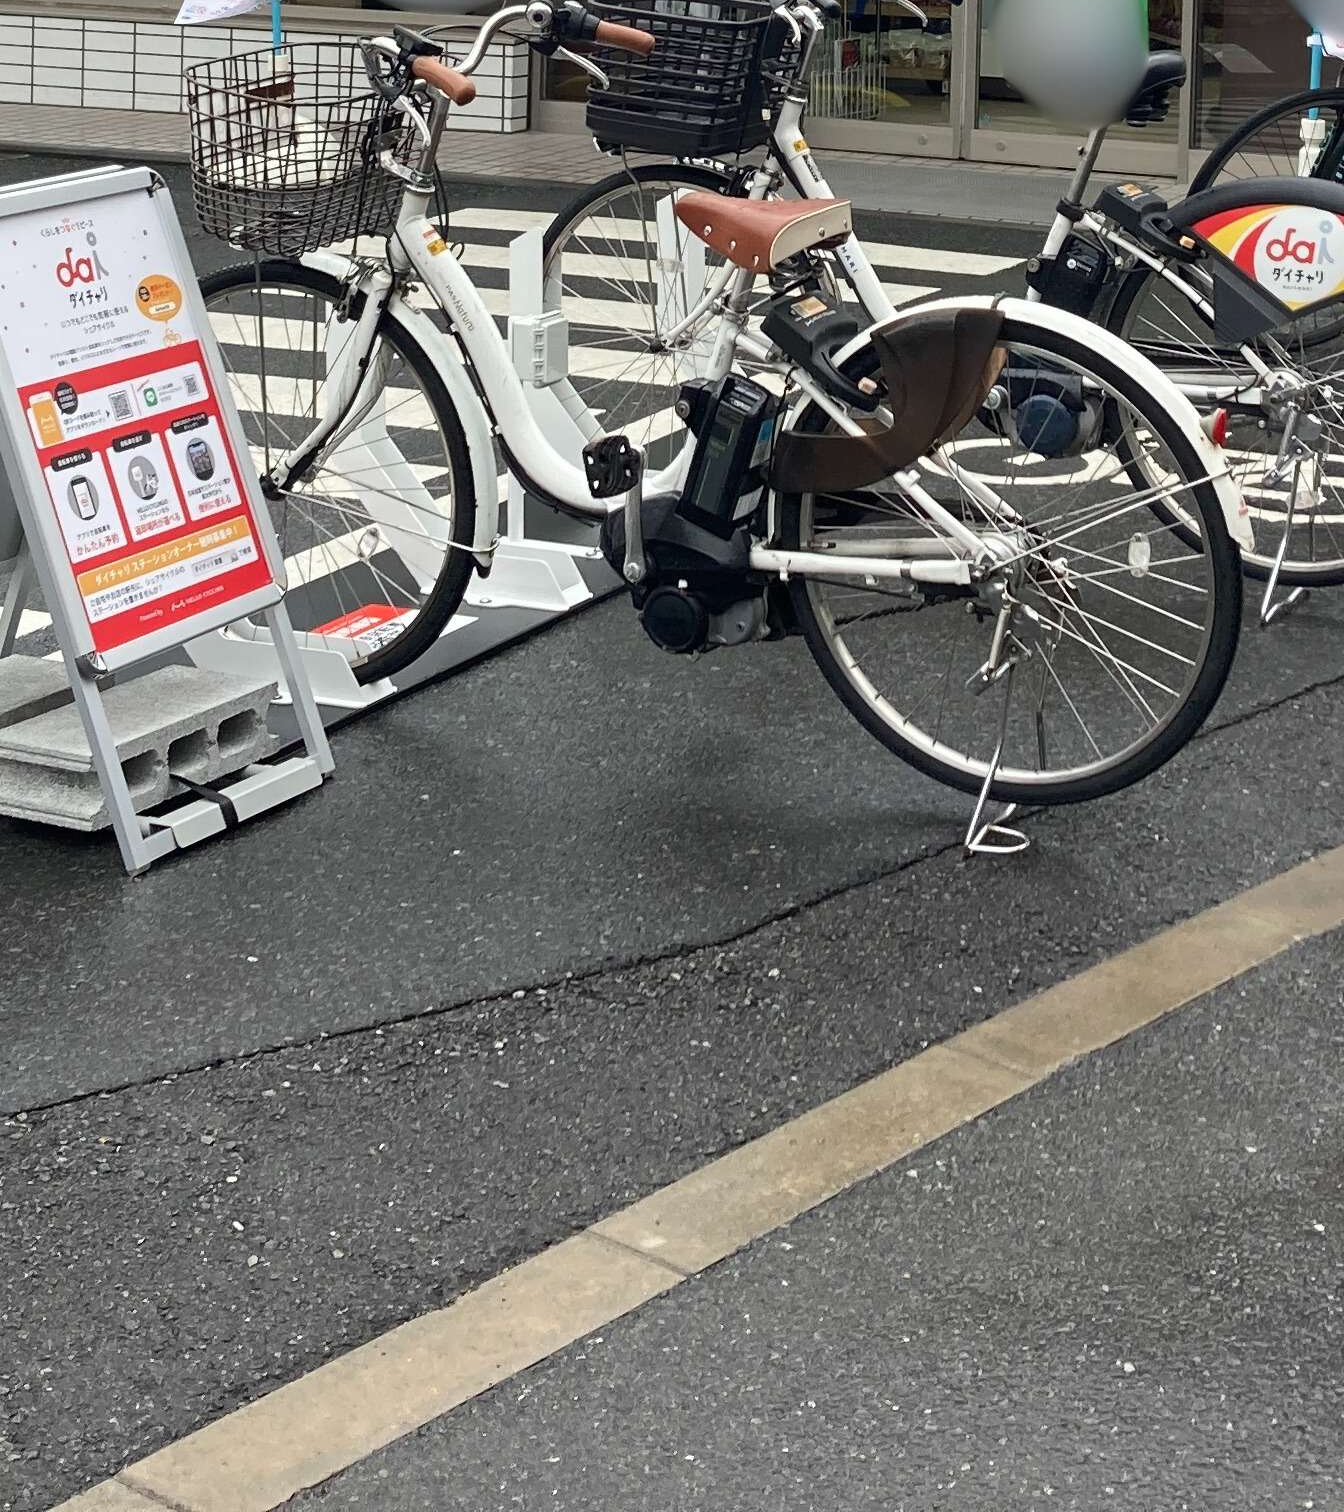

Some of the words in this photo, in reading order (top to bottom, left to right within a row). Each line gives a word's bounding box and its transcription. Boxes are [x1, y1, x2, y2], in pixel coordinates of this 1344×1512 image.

[56, 231, 110, 287] dai
[1265, 219, 1336, 265] dai
[1272, 267, 1325, 285] ダイチャリ
[69, 286, 108, 309] ダイチャリ
